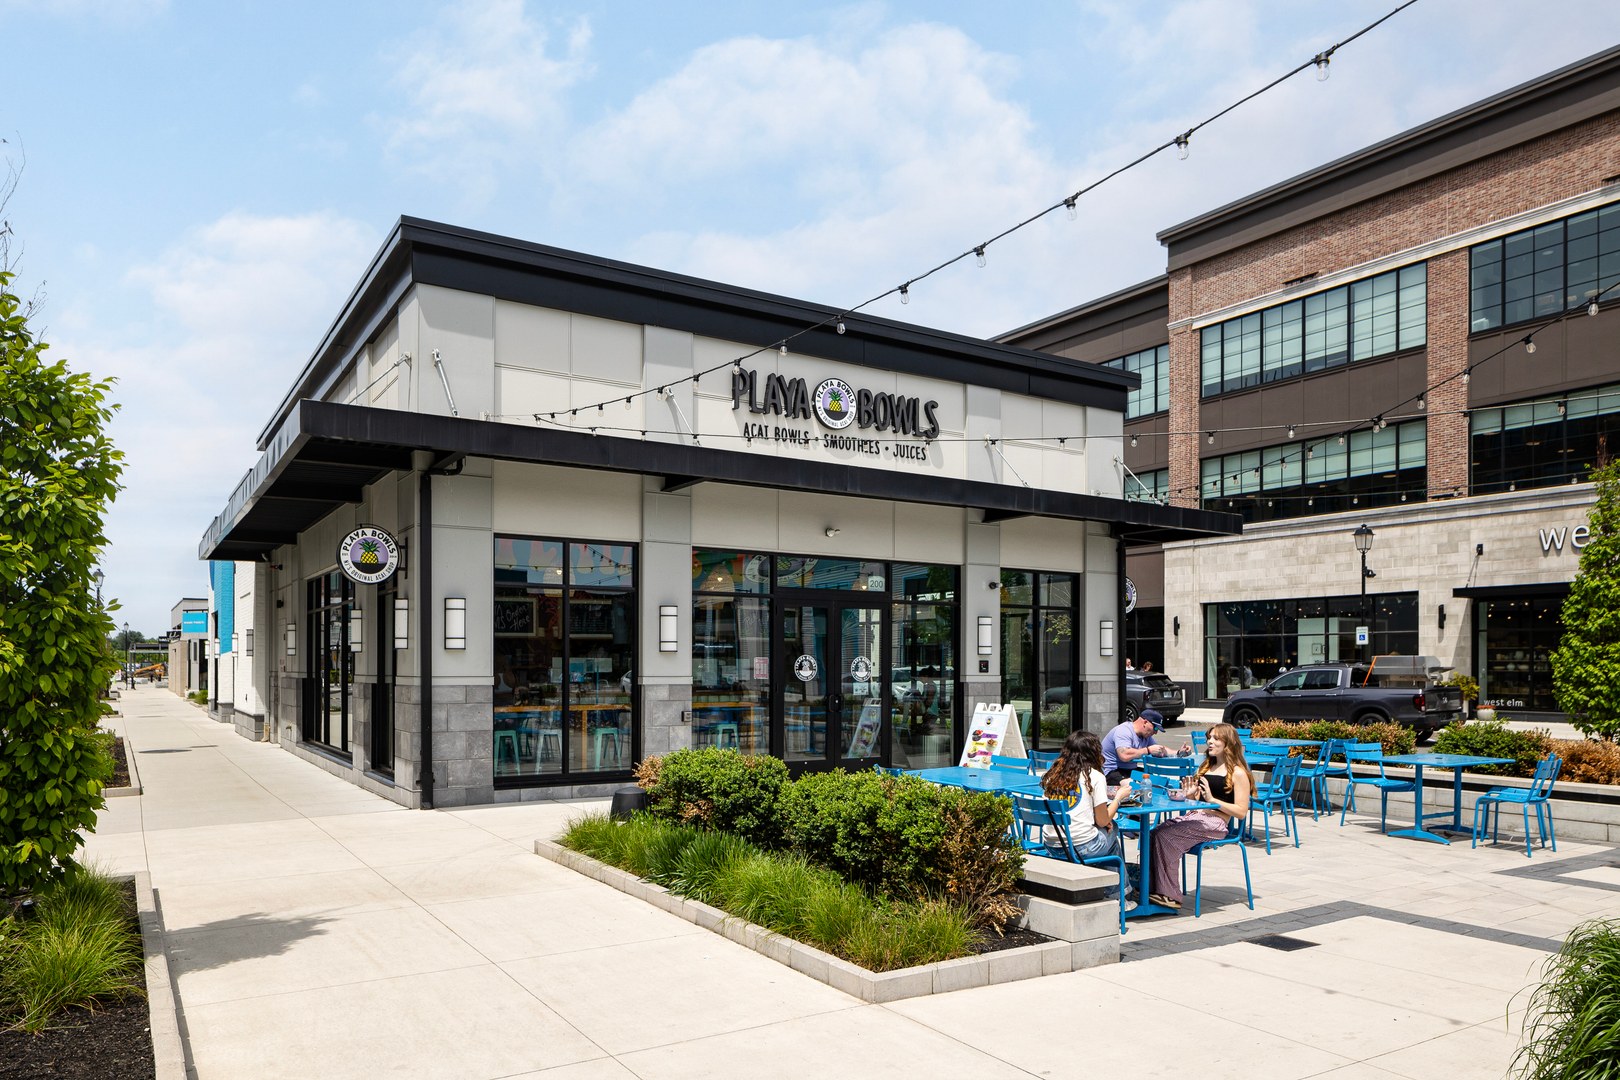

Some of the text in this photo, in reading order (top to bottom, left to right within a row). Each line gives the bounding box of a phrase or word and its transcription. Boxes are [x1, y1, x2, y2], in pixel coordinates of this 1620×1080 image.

[732, 368, 939, 439] PLAYA BOWLS
[816, 381, 855, 404] PLAYA BOWLS
[774, 426, 809, 445] BOWLS
[893, 443, 927, 461] JUICES
[342, 530, 396, 554] PLAYA BOWLS
[351, 570, 373, 581] ORIGINAL
[375, 573, 387, 581] ACAI
[869, 580, 884, 588] 200
[1506, 698, 1523, 707] elm
